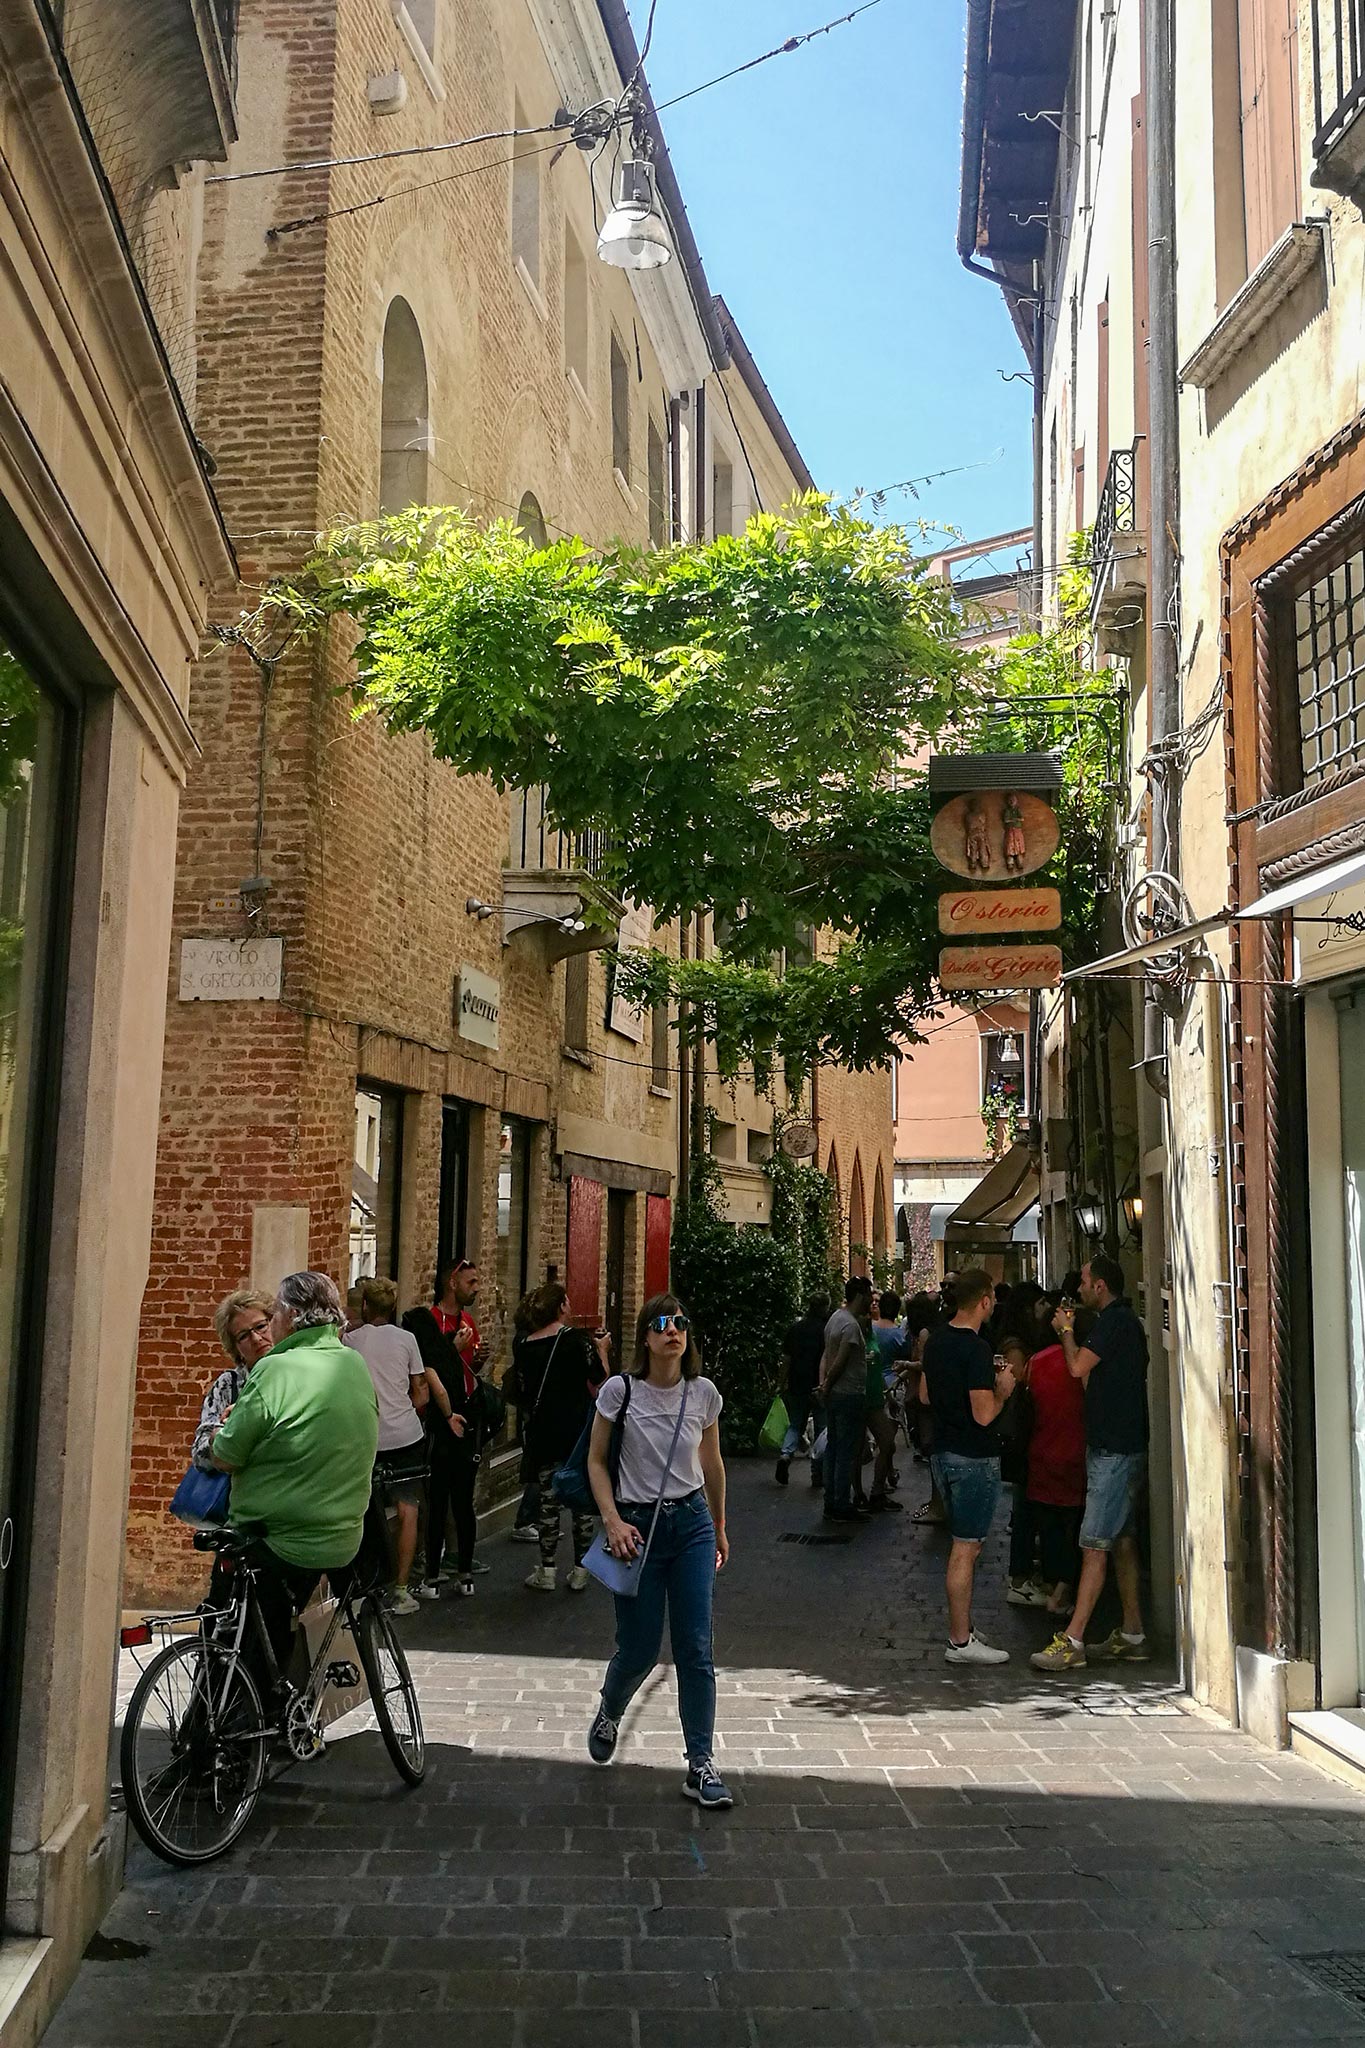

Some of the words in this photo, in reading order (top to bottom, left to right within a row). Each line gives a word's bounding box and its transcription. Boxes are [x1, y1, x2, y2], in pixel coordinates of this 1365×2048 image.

[950, 896, 1050, 921] Osteria
[205, 950, 259, 966] VICOLO
[941, 960, 980, 975] Dalla
[983, 955, 1060, 981] Gigia
[182, 972, 196, 988] S.
[201, 972, 278, 988] GREGORIO
